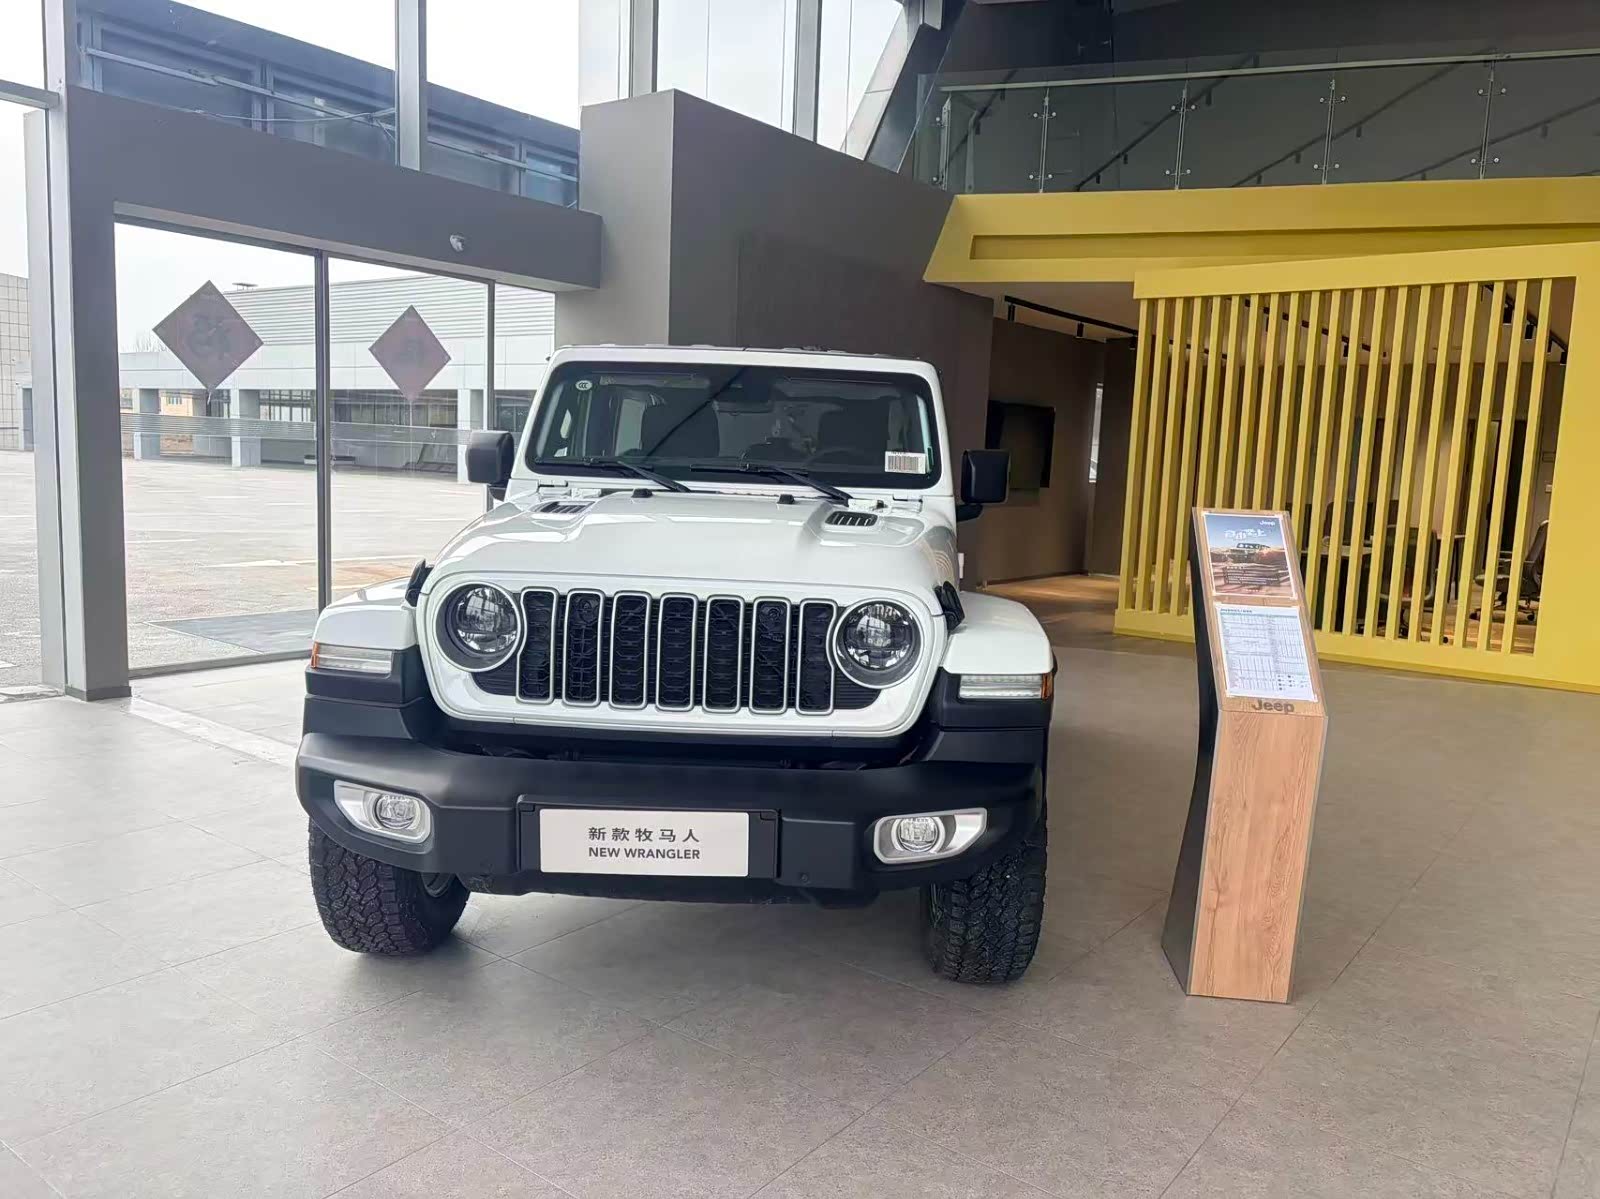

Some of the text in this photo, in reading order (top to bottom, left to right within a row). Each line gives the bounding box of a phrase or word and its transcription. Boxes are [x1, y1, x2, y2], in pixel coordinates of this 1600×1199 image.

[1252, 700, 1295, 714] Jeep
[588, 827, 700, 842] 新款牧马人
[588, 847, 700, 859] NEW WRANGLER
